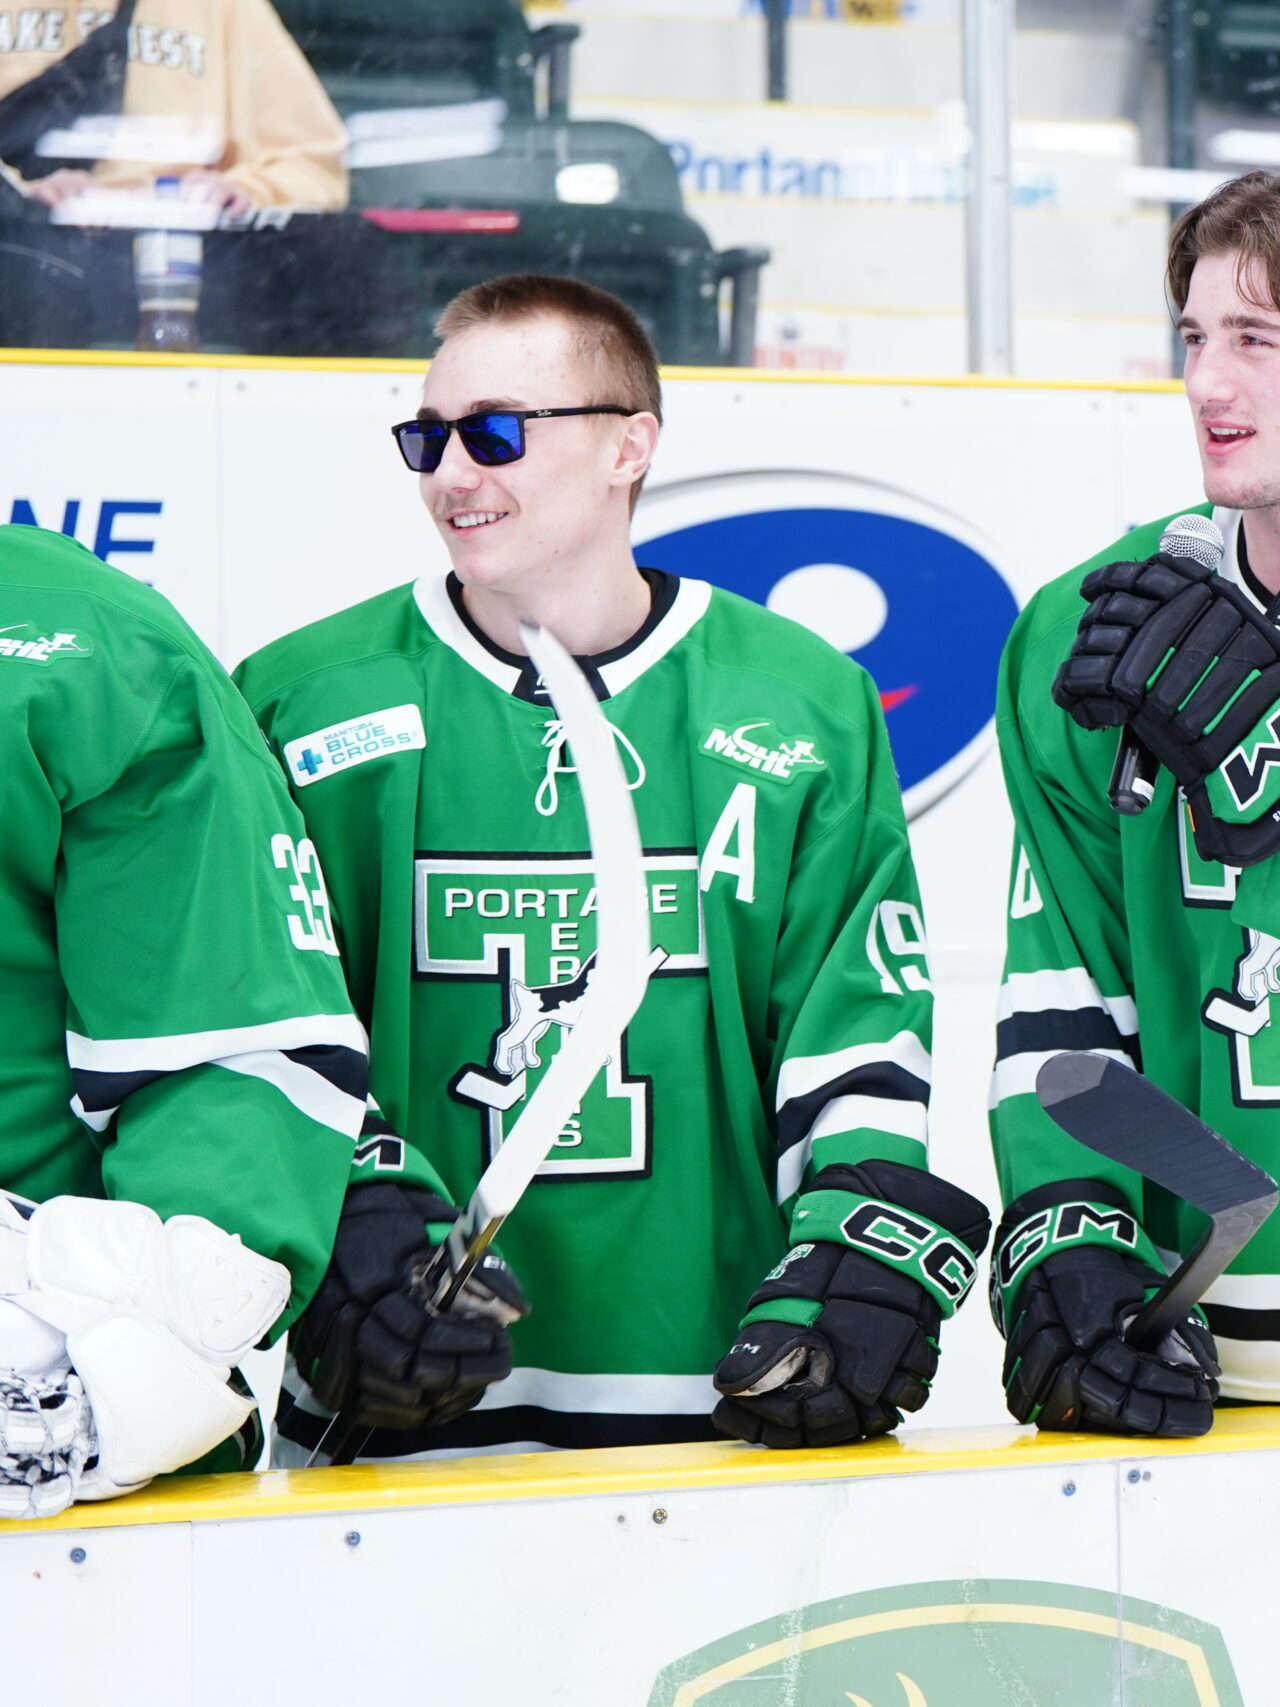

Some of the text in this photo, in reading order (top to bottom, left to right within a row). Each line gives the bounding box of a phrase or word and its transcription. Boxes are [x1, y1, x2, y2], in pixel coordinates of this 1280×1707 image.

[76, 8, 208, 77] FEST
[325, 724, 387, 753] BLUE
[330, 732, 412, 766] CROSS
[699, 781, 757, 904] A
[270, 833, 341, 957] 33
[444, 883, 679, 920] PORTAE
